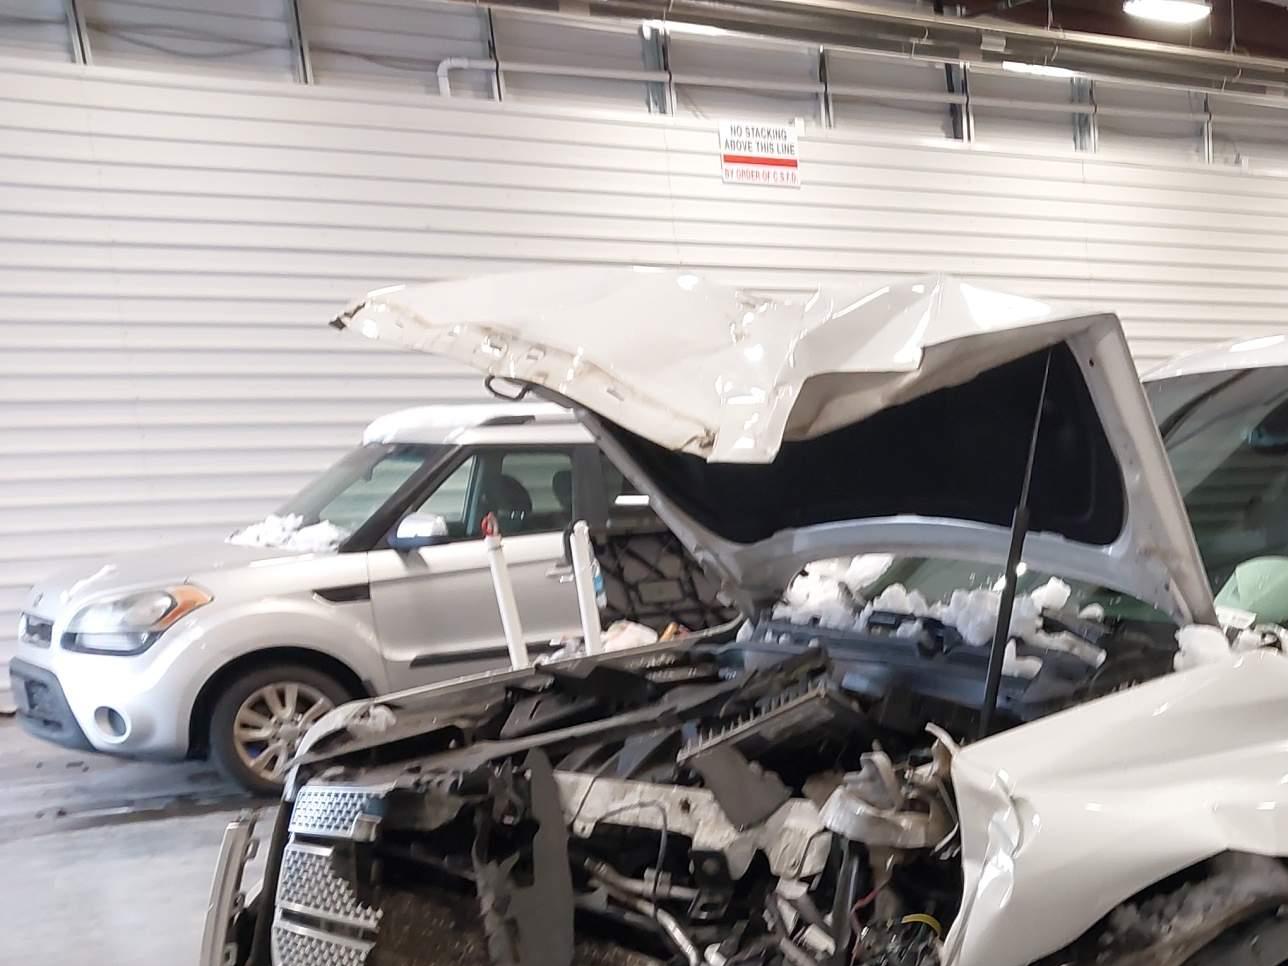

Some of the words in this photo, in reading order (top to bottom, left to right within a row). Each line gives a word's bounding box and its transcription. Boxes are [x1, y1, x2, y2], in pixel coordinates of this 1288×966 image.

[730, 125, 742, 138] NO
[745, 127, 787, 141] STACKING
[724, 138, 752, 153] ABOVE
[756, 140, 774, 155] THIS
[777, 143, 795, 156] LINE
